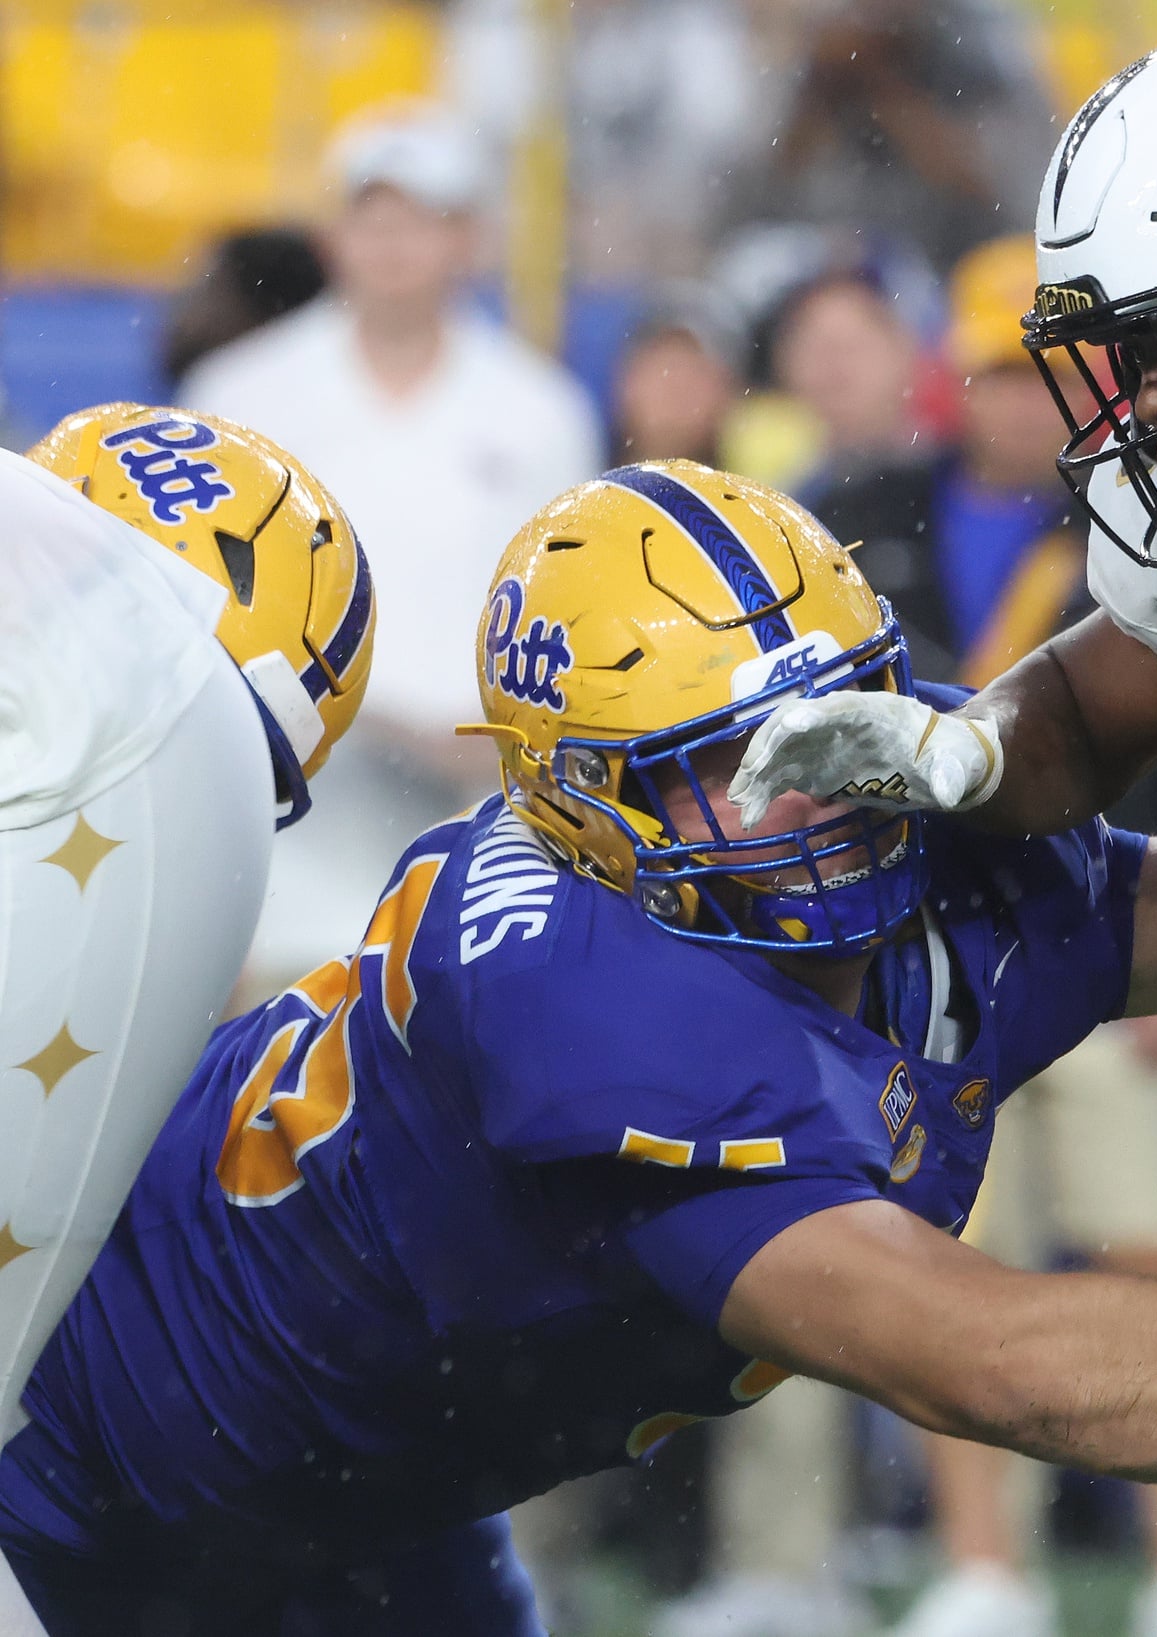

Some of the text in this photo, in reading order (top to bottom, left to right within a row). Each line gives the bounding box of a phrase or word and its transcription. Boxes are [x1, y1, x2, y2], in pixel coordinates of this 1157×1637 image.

[102, 419, 234, 525] Pitt
[484, 577, 574, 713] Pitt
[765, 645, 818, 685] ACC
[883, 1071, 912, 1130] UPMC
